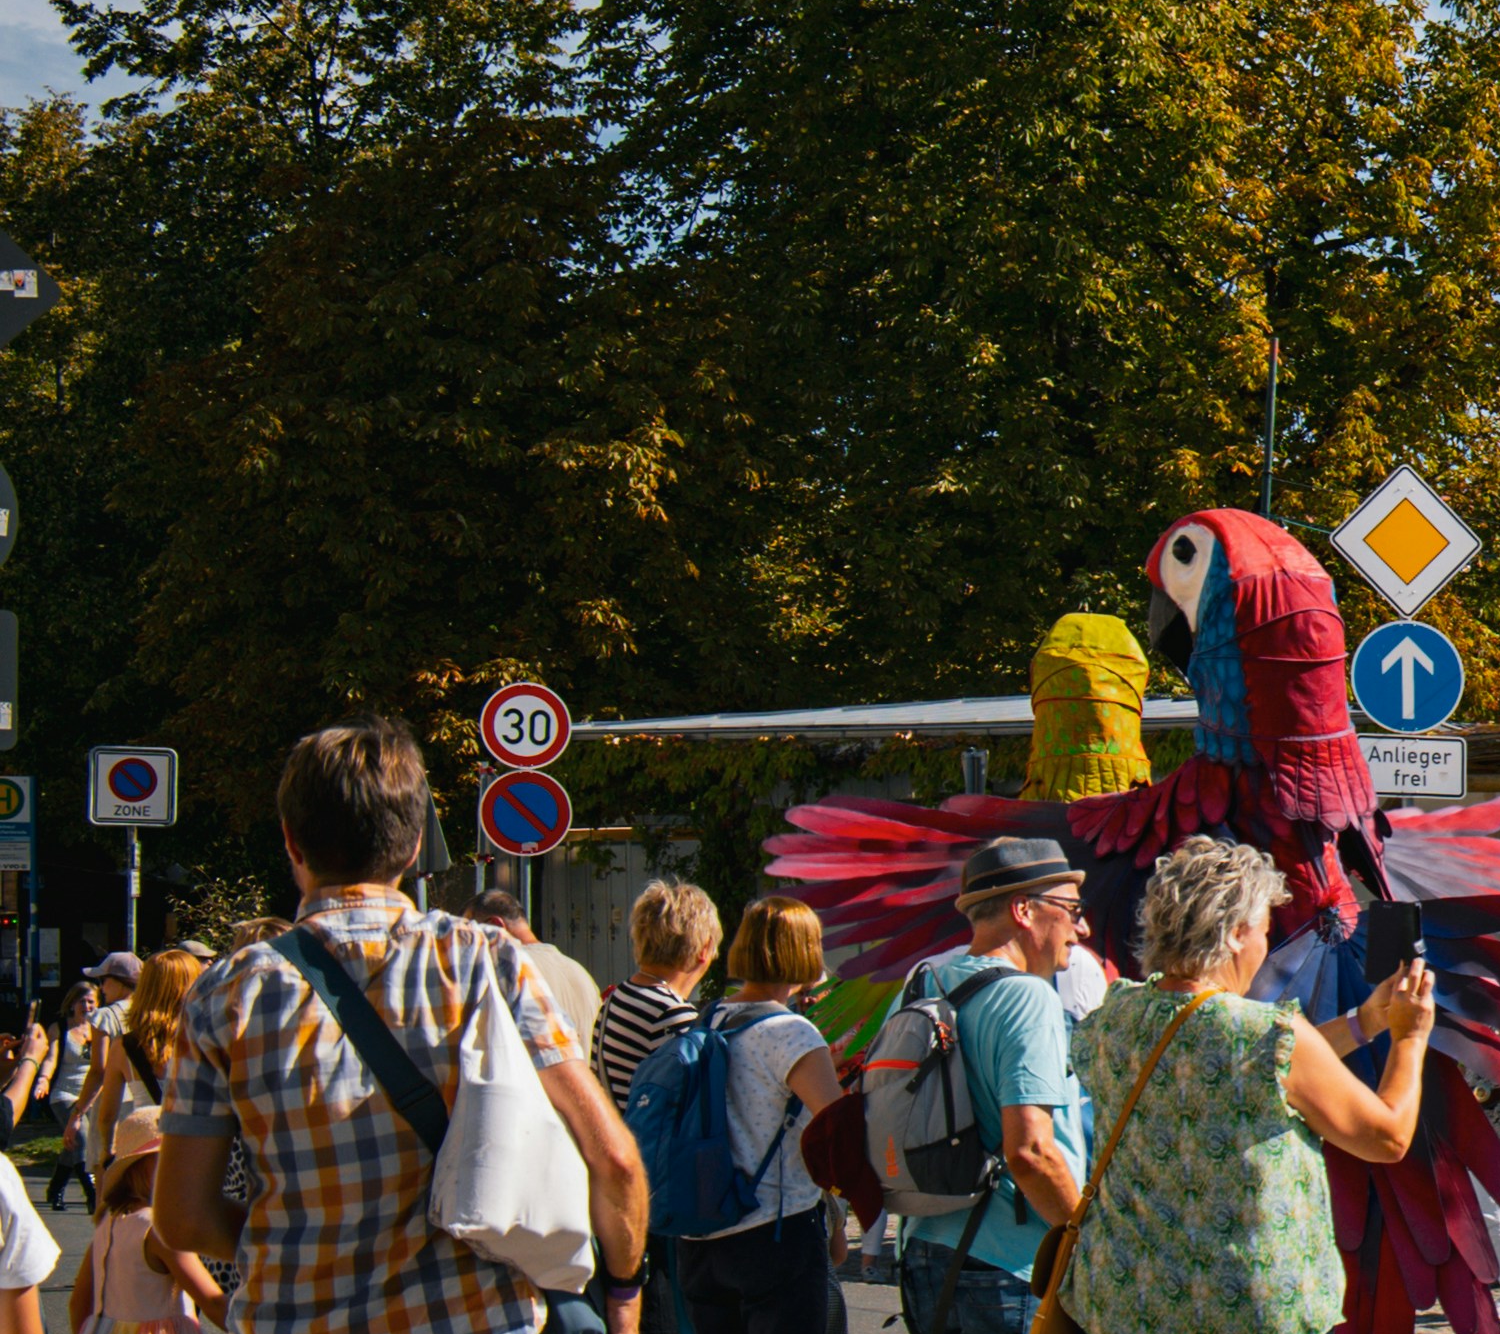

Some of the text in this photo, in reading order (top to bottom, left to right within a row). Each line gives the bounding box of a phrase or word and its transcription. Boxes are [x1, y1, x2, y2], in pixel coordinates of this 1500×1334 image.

[502, 707, 551, 746] 30
[1368, 745, 1452, 769] Anlieger
[1394, 769, 1427, 787] frei
[114, 805, 151, 817] ZONE
